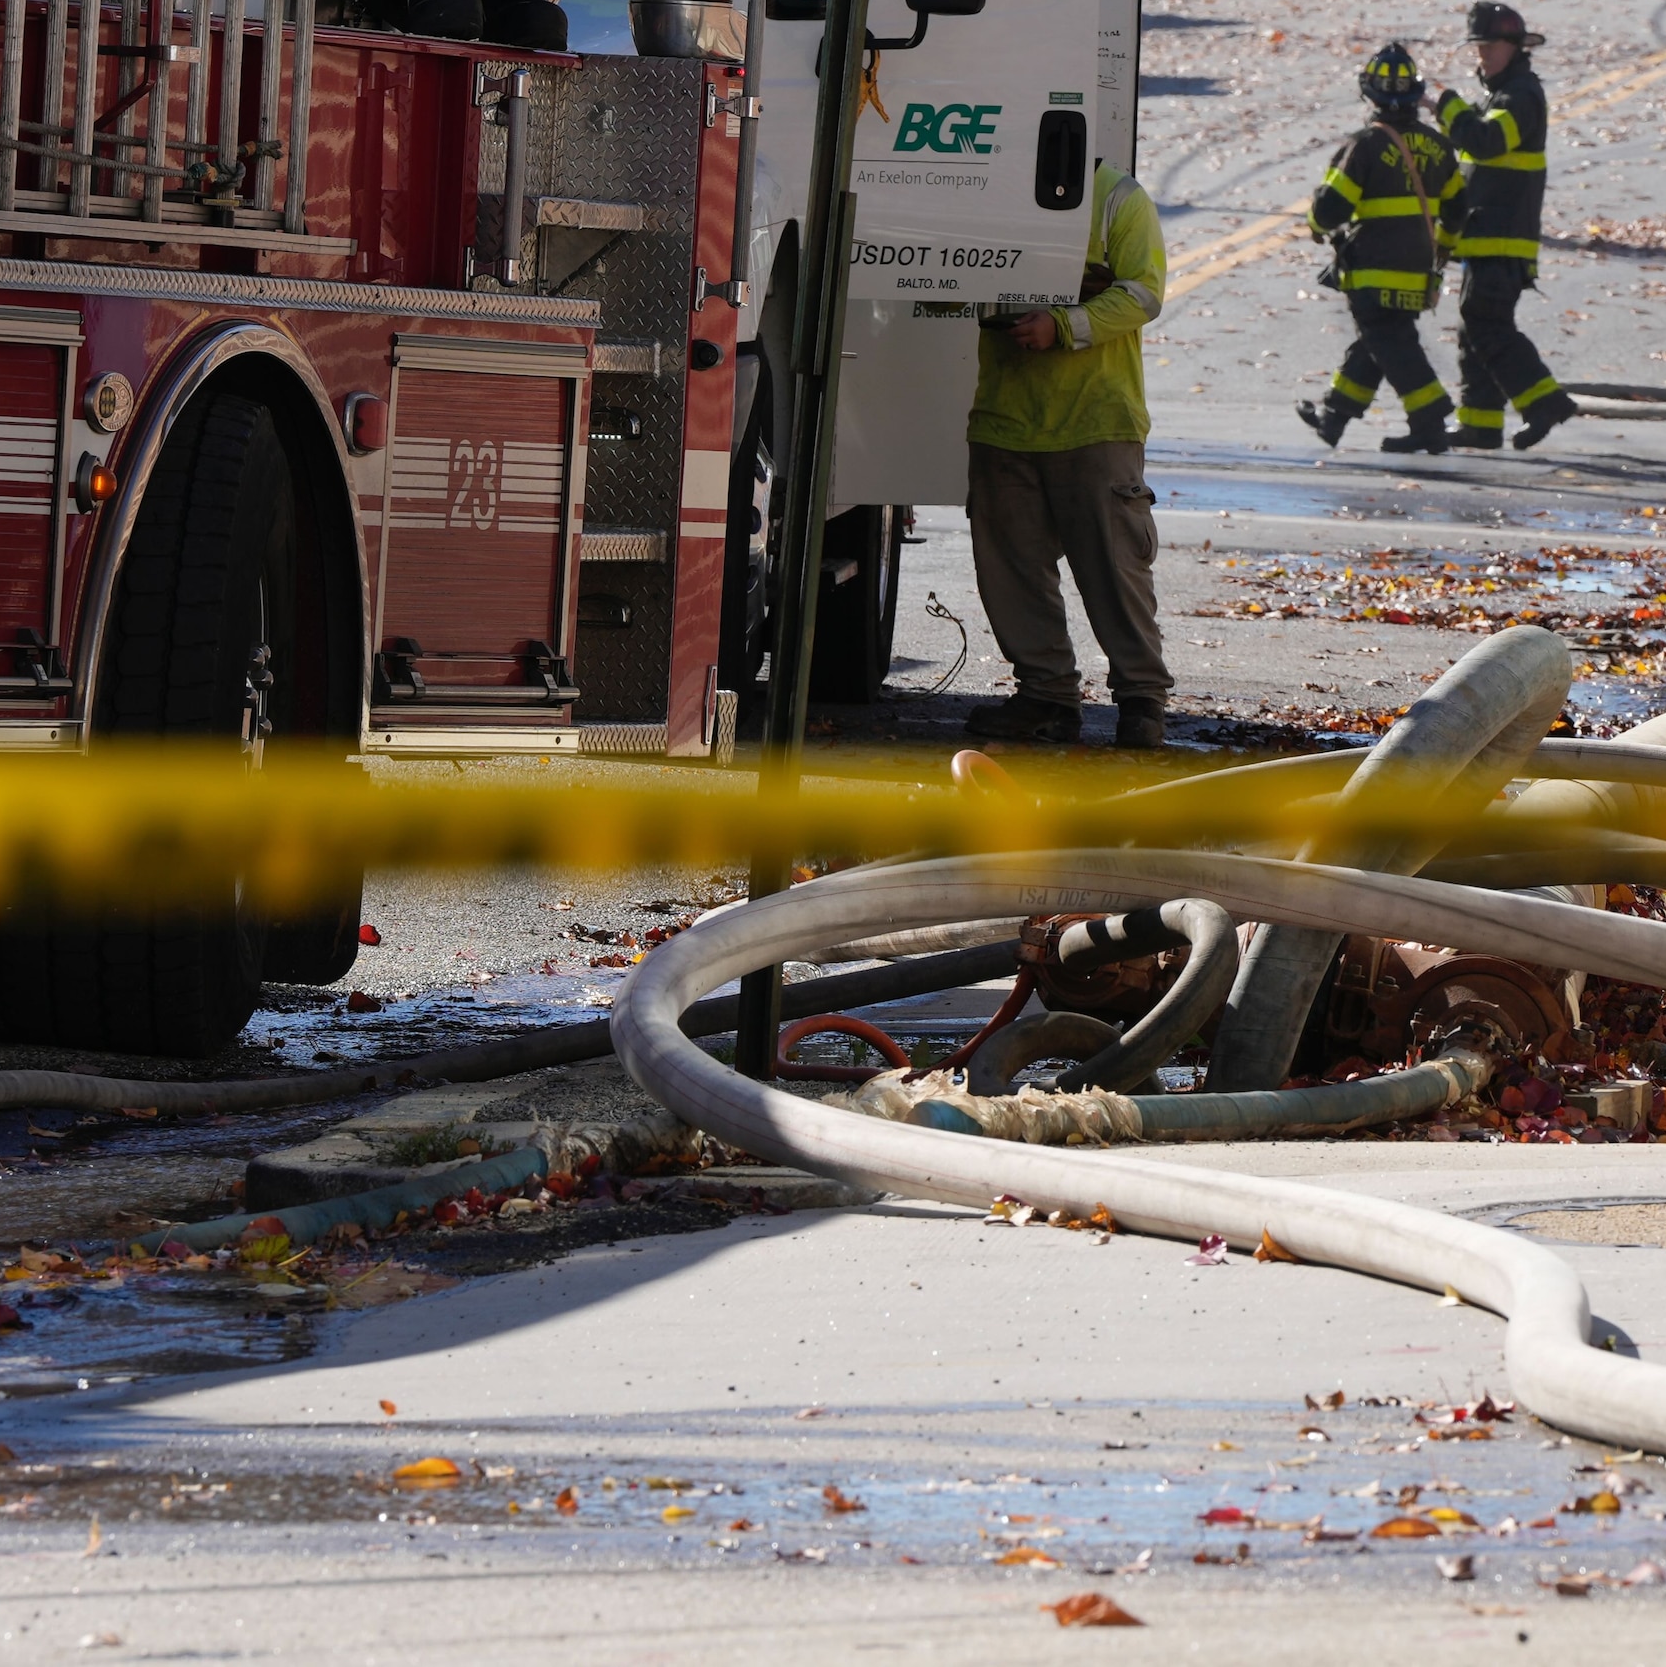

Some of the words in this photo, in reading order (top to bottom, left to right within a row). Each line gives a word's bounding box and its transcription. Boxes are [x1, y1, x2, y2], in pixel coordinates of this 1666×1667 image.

[893, 103, 1002, 154] BGE
[857, 170, 875, 183] An
[879, 170, 921, 185] Exelon
[925, 171, 989, 190] Company
[939, 248, 1022, 269] 160257
[897, 278, 935, 289] BALTO.
[938, 279, 960, 290] MD.
[997, 293, 1027, 304] DIESEL
[1029, 294, 1050, 304] FUEL
[1052, 294, 1075, 304] ONLY
[450, 439, 497, 530] 23
